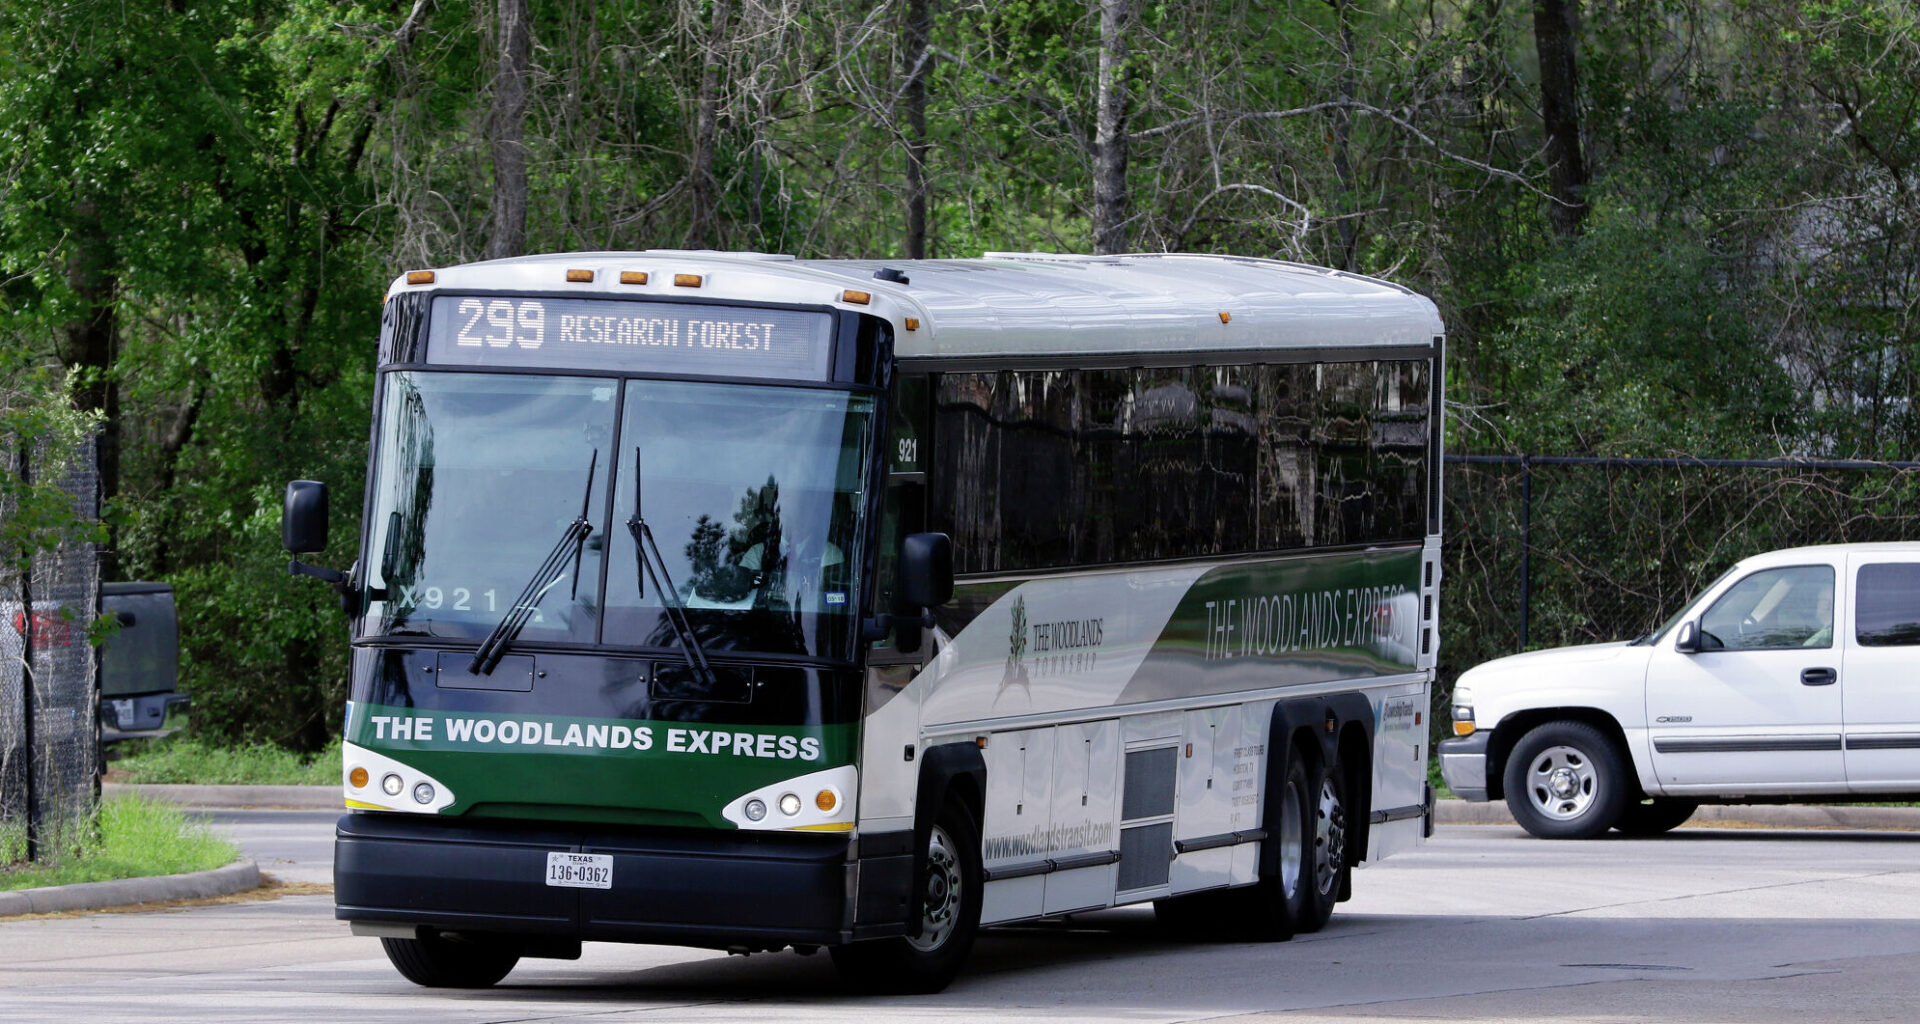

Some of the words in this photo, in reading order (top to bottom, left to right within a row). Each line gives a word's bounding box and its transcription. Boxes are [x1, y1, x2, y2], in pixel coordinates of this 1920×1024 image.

[457, 299, 545, 349] 299
[560, 315, 678, 346] RESEARCH
[688, 320, 775, 350] FOREST
[898, 438, 917, 462] 921
[1034, 624, 1050, 651] THE
[1051, 618, 1103, 650] WOODLANDS
[1206, 600, 1237, 661] THE
[1241, 589, 1341, 657] WOODLANDS
[1344, 584, 1405, 646] EXPRESS
[1034, 652, 1096, 677] TOWNSHIP
[371, 716, 433, 741] THE
[445, 718, 653, 751] WOODLANDS
[667, 729, 820, 761] EXPRESS
[985, 818, 1112, 860] www.woodlandstransit.com
[568, 855, 593, 863] TEXAS
